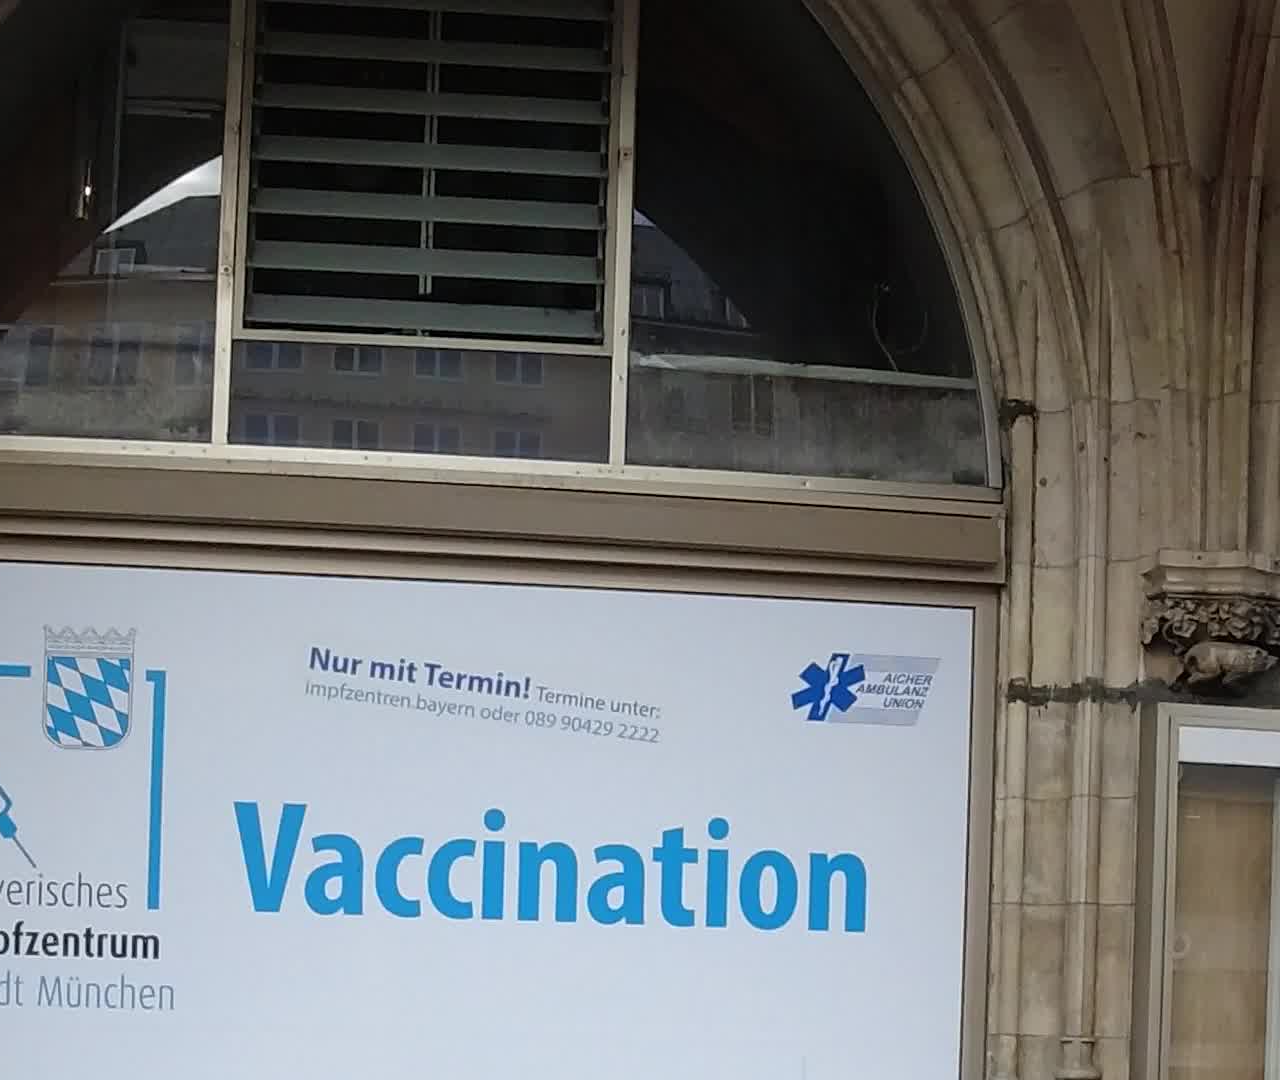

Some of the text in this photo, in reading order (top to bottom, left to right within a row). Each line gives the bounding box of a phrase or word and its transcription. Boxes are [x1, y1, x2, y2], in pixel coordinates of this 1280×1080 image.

[309, 646, 661, 719] Nur mit Termin! Termine unter:
[856, 683, 929, 698] AMBULANZ
[883, 673, 933, 686] AICHER
[304, 679, 660, 743] impfzentren.bayern oder 089 90429 2222
[883, 697, 925, 709] UNION
[233, 800, 868, 933] Vaccination
[37, 973, 176, 1012] München
